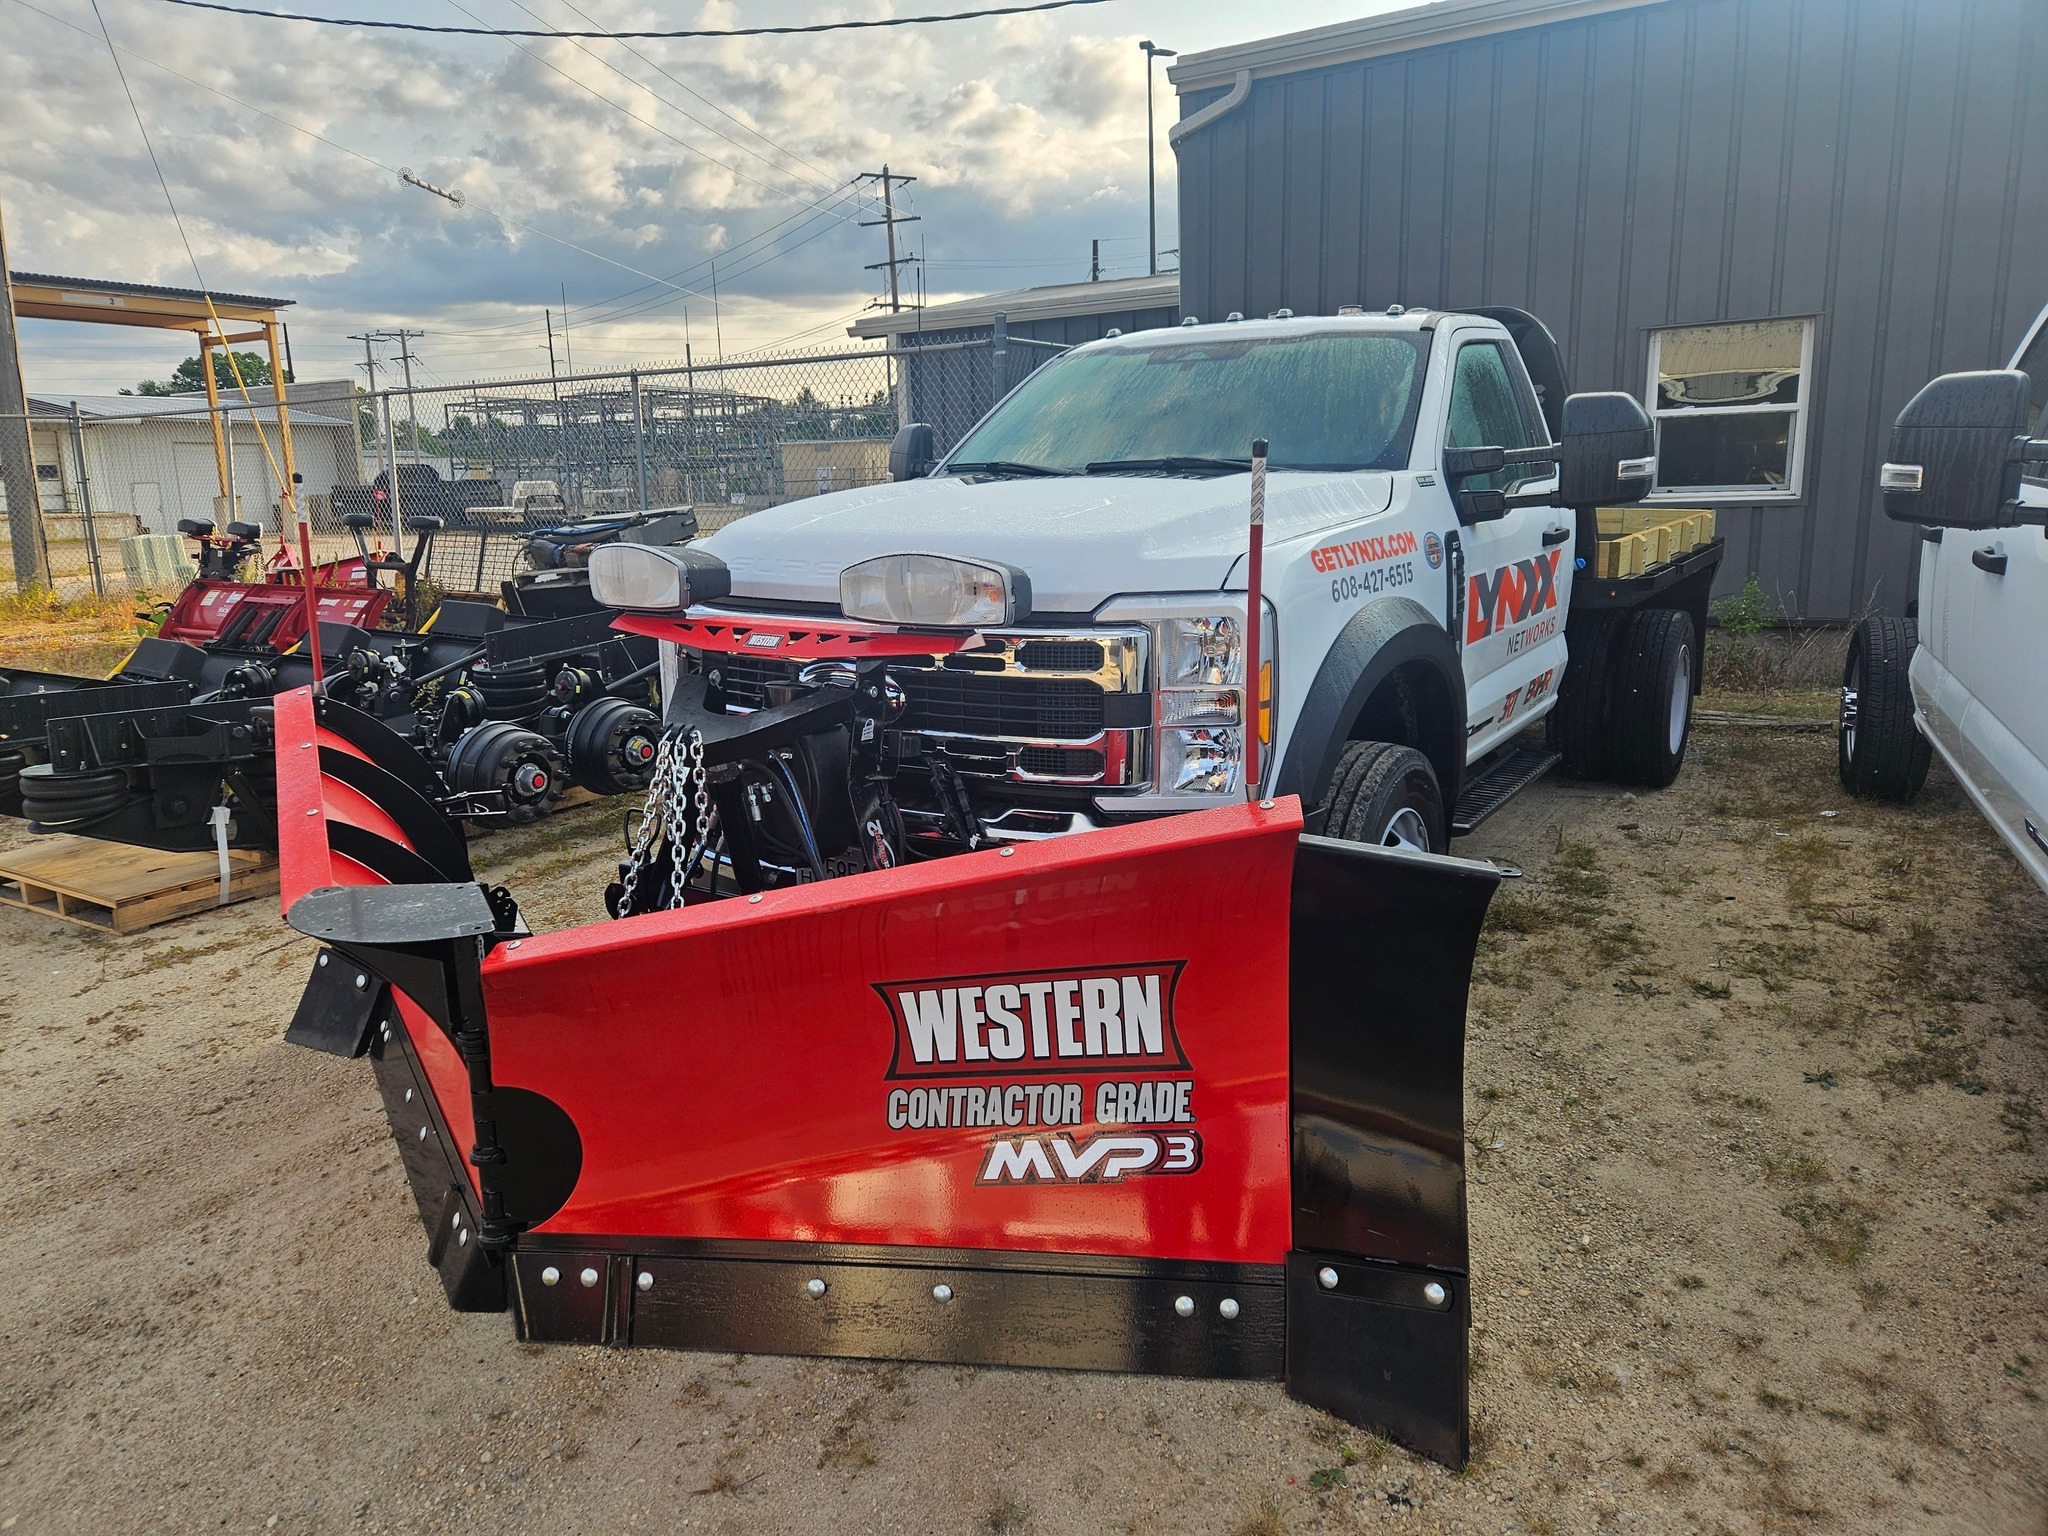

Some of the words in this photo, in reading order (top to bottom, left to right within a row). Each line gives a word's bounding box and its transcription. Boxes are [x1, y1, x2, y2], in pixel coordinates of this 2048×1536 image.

[109, 297, 115, 305] 3
[1311, 531, 1418, 573] GETLYNXX.COM
[1332, 562, 1413, 603] 608-427-6515
[1466, 549, 1562, 646] LYNXX
[748, 634, 781, 647] WESTERN
[1507, 616, 1556, 656] NETWORKS
[897, 974, 1165, 1064] WESTERN
[887, 1082, 1084, 1130] CONTRACTOR
[1096, 1081, 1194, 1125] GRADE
